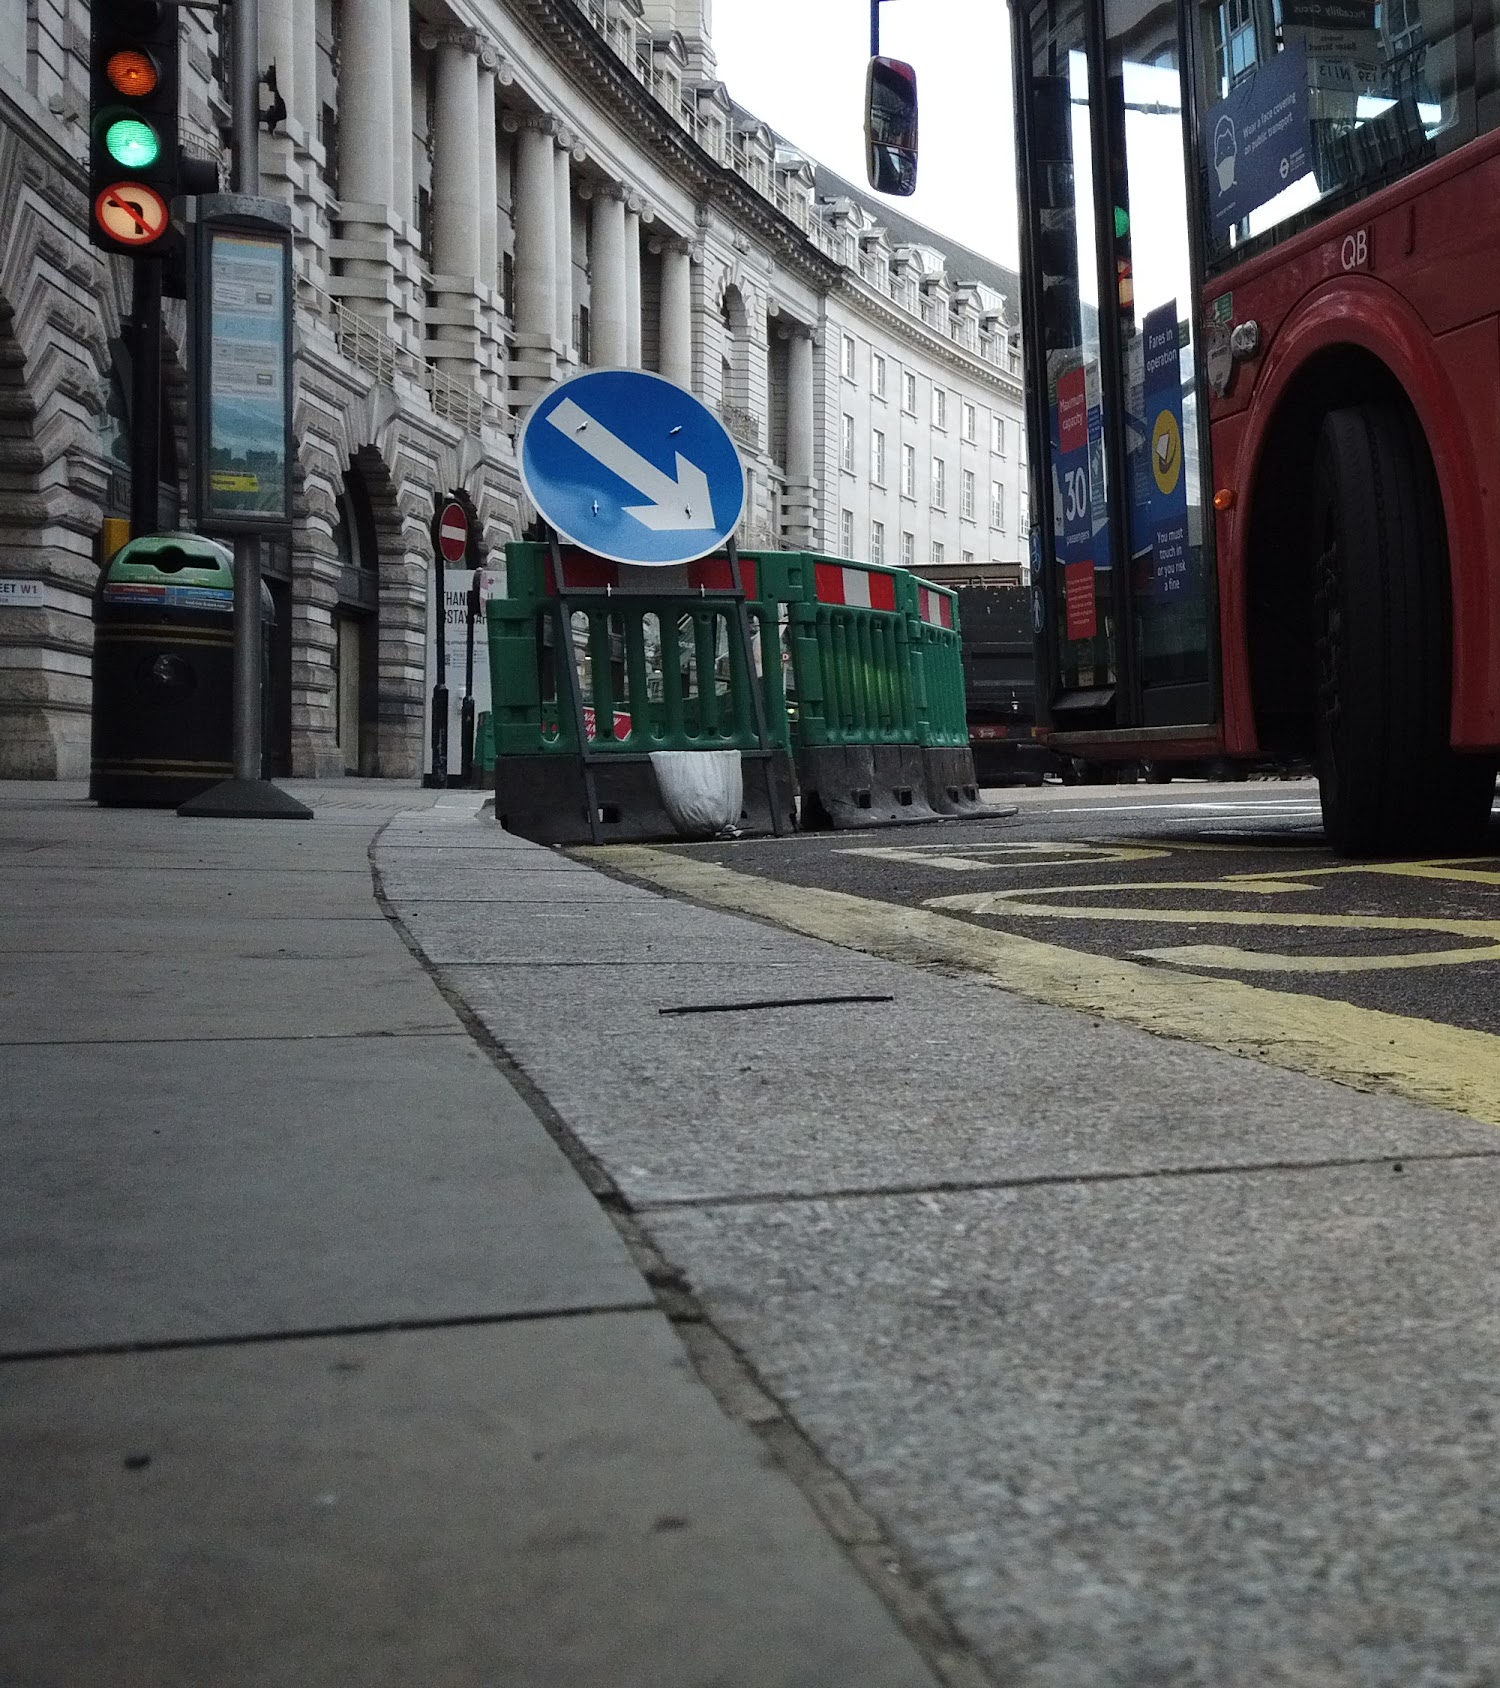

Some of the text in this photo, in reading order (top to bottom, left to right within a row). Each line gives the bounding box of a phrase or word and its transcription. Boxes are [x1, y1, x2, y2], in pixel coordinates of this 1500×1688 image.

[1242, 121, 1257, 139] Wear
[1260, 109, 1274, 125] face
[1272, 91, 1297, 116] covering
[1251, 131, 1268, 153] public
[1267, 111, 1294, 138] transport
[1341, 229, 1368, 271] QB
[1148, 327, 1174, 350] Fares in
[1146, 348, 1178, 374] operation
[1059, 393, 1085, 413] Maximum
[1062, 412, 1084, 432] capacity
[1064, 466, 1087, 522] 30
[1066, 530, 1091, 548] passengers
[1156, 527, 1184, 544] You must
[1159, 543, 1183, 560] touch in
[1157, 559, 1187, 578] or you risk
[20, 583, 37, 594] W1
[1168, 577, 1181, 591] fine
